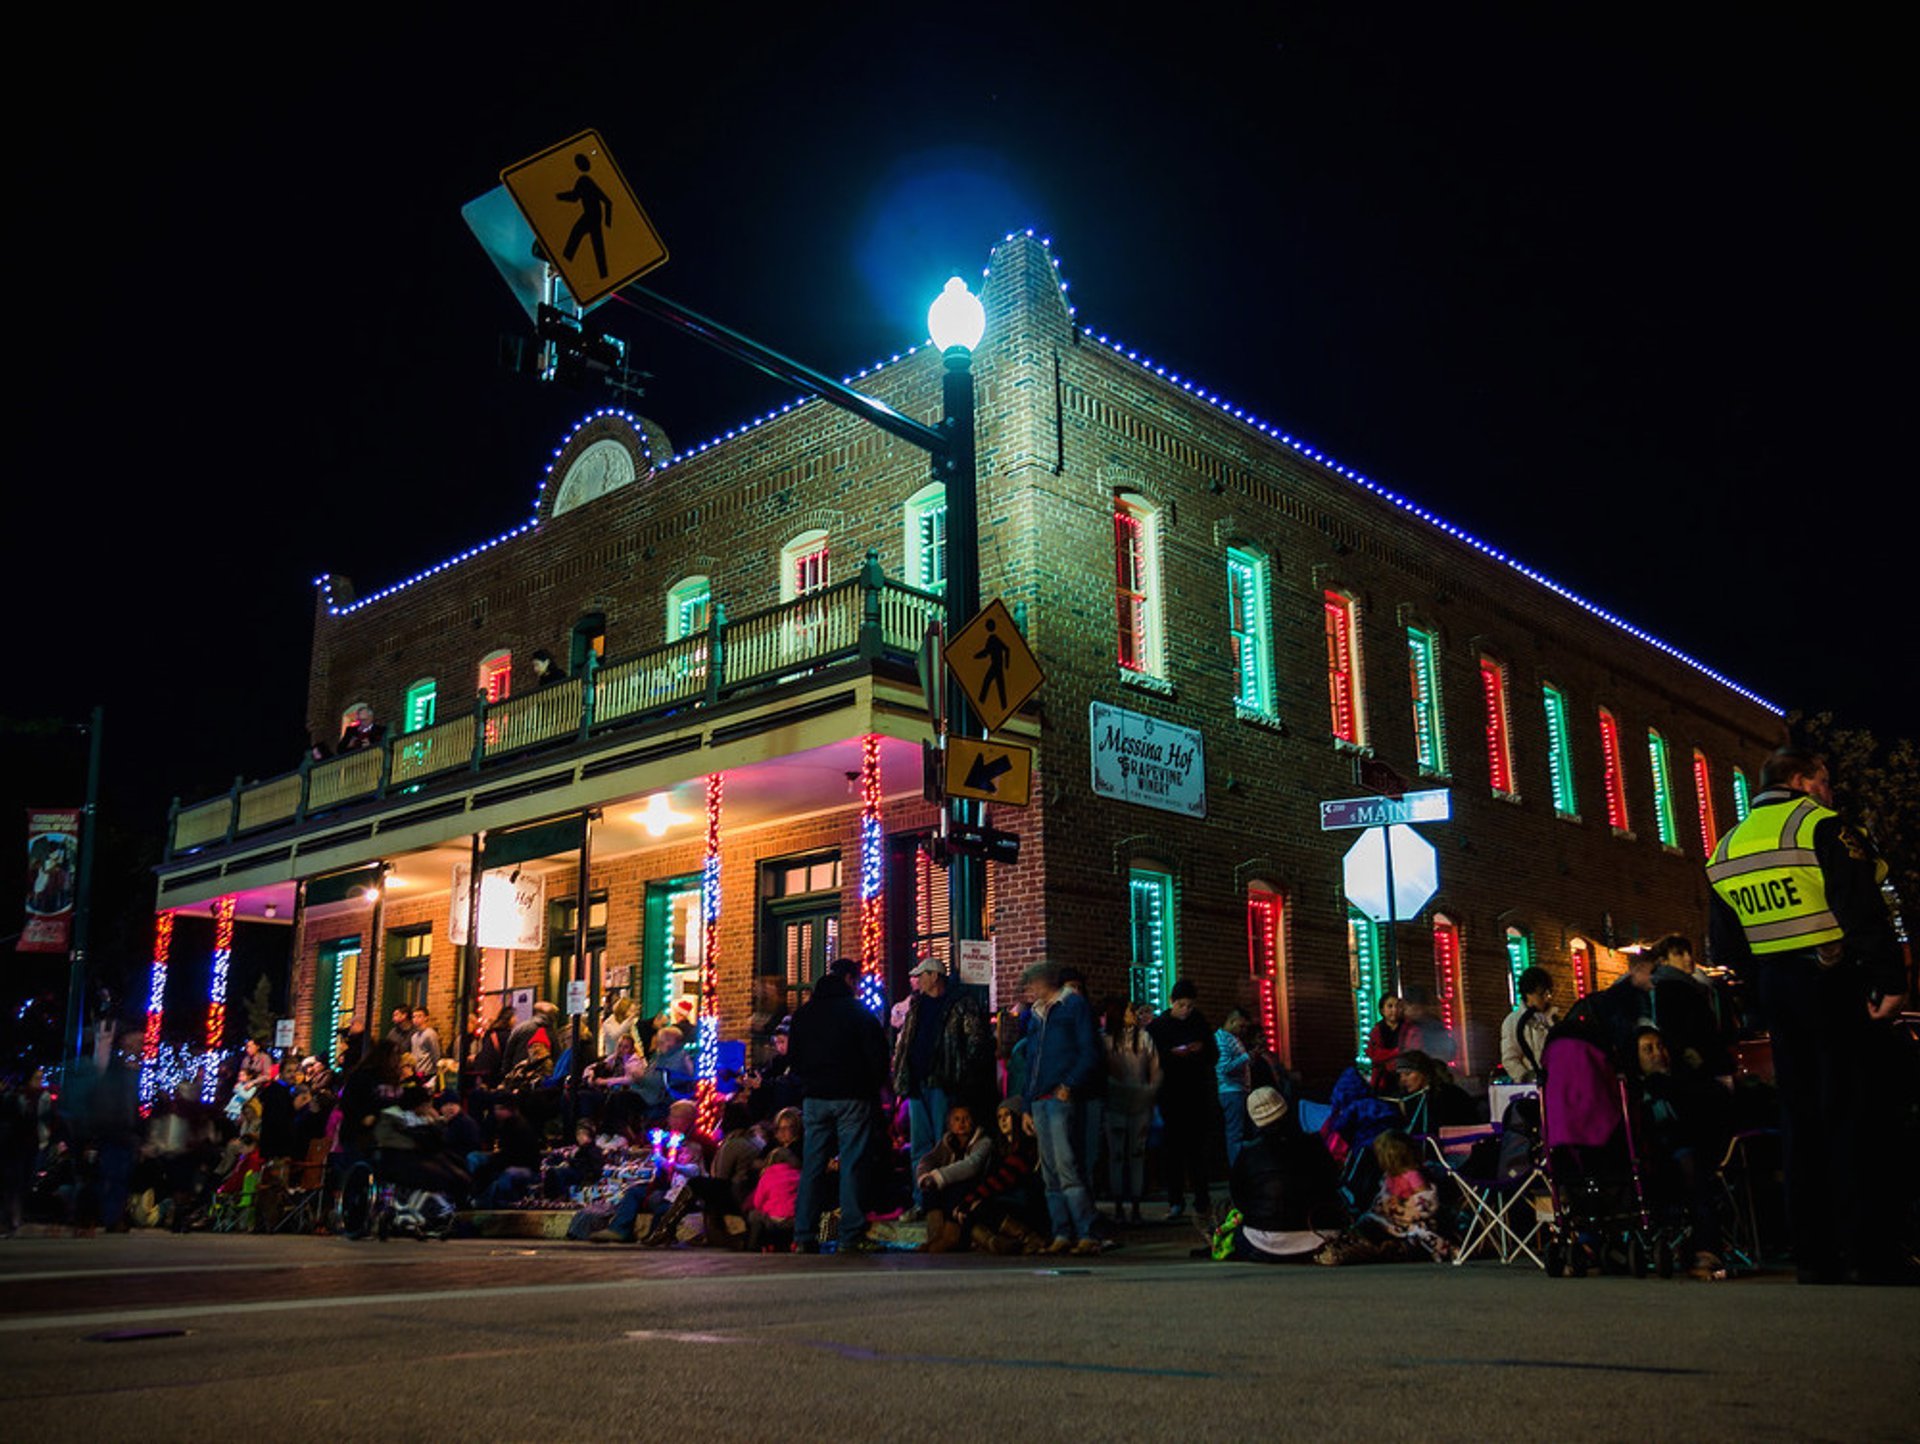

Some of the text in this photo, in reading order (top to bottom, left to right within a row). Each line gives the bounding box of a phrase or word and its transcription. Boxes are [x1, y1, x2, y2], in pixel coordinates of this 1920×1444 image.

[1099, 724, 1195, 776] Messina Hof
[1357, 801, 1408, 823] MAIN
[1729, 877, 1802, 915] POLICE
